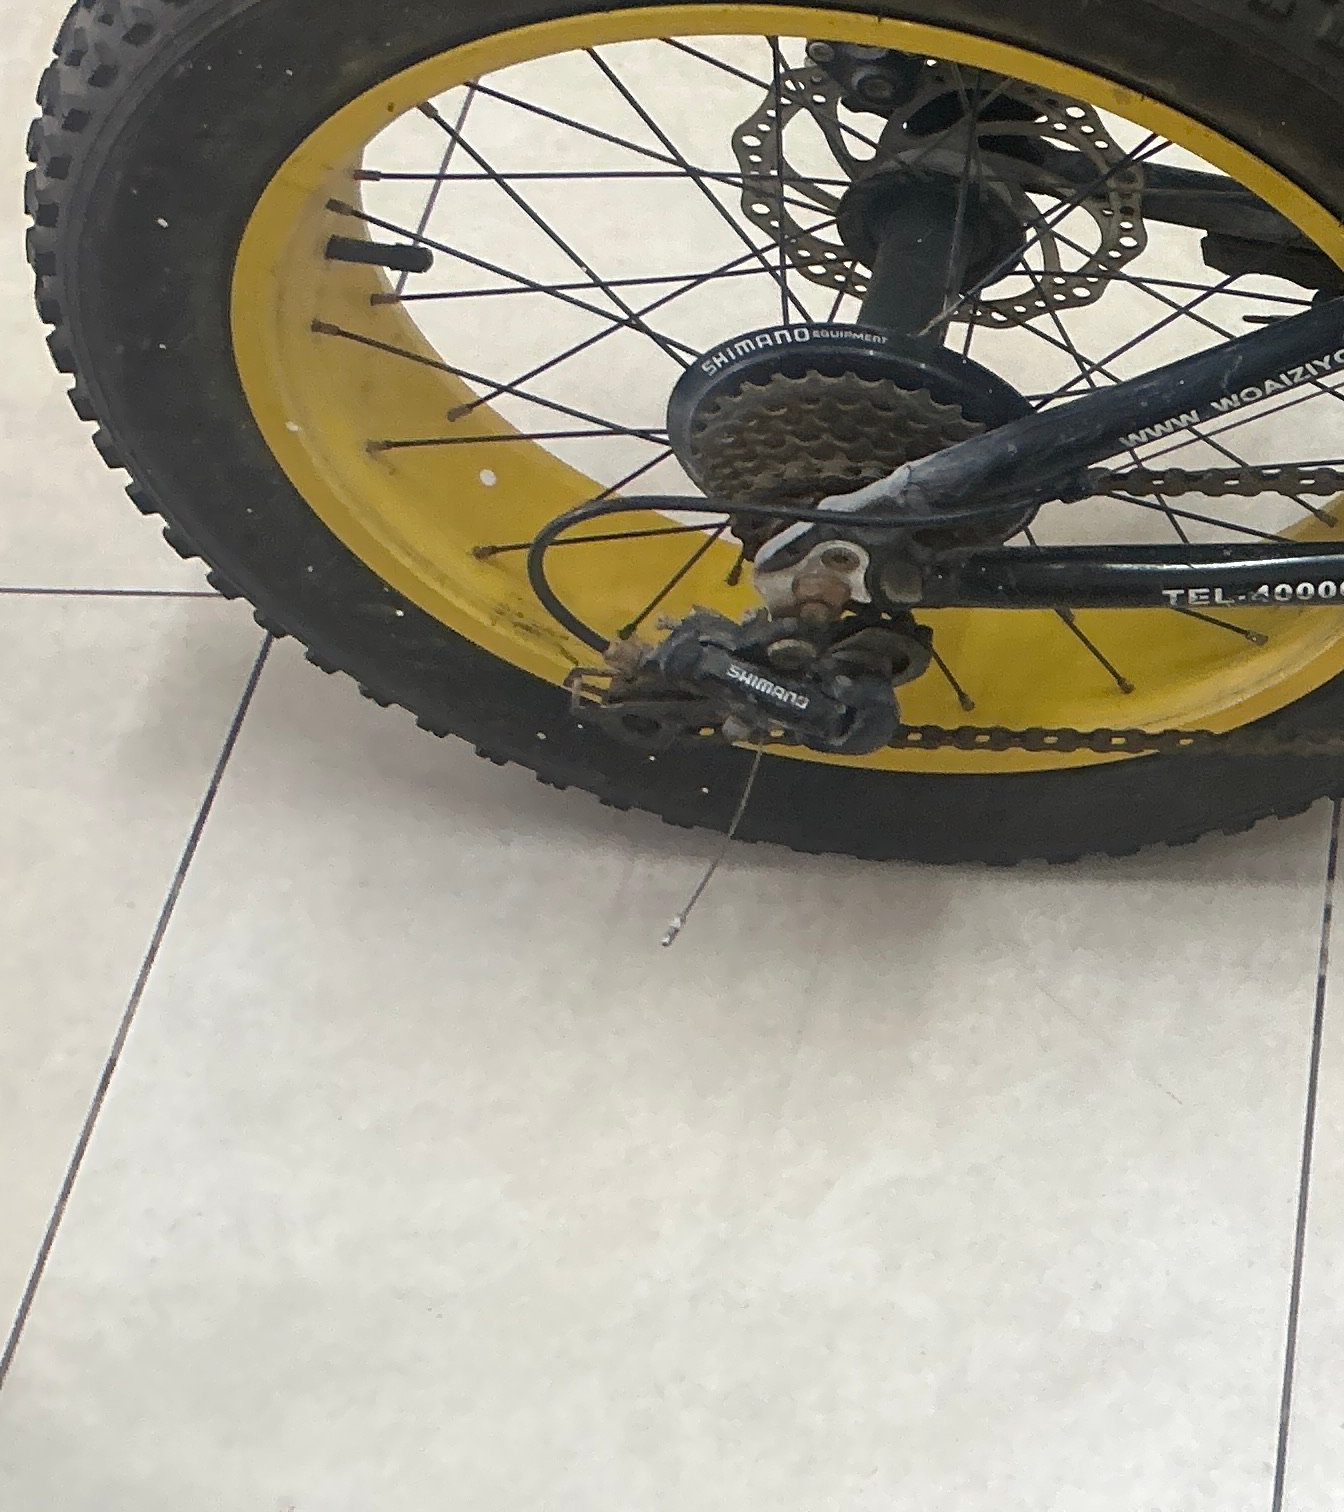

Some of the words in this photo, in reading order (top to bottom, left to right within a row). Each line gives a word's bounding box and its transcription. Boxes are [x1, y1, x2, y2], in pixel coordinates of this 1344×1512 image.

[701, 327, 810, 377] SHIMANO
[812, 330, 888, 344] EQUIPMENT
[726, 663, 811, 710] SHIMANO
